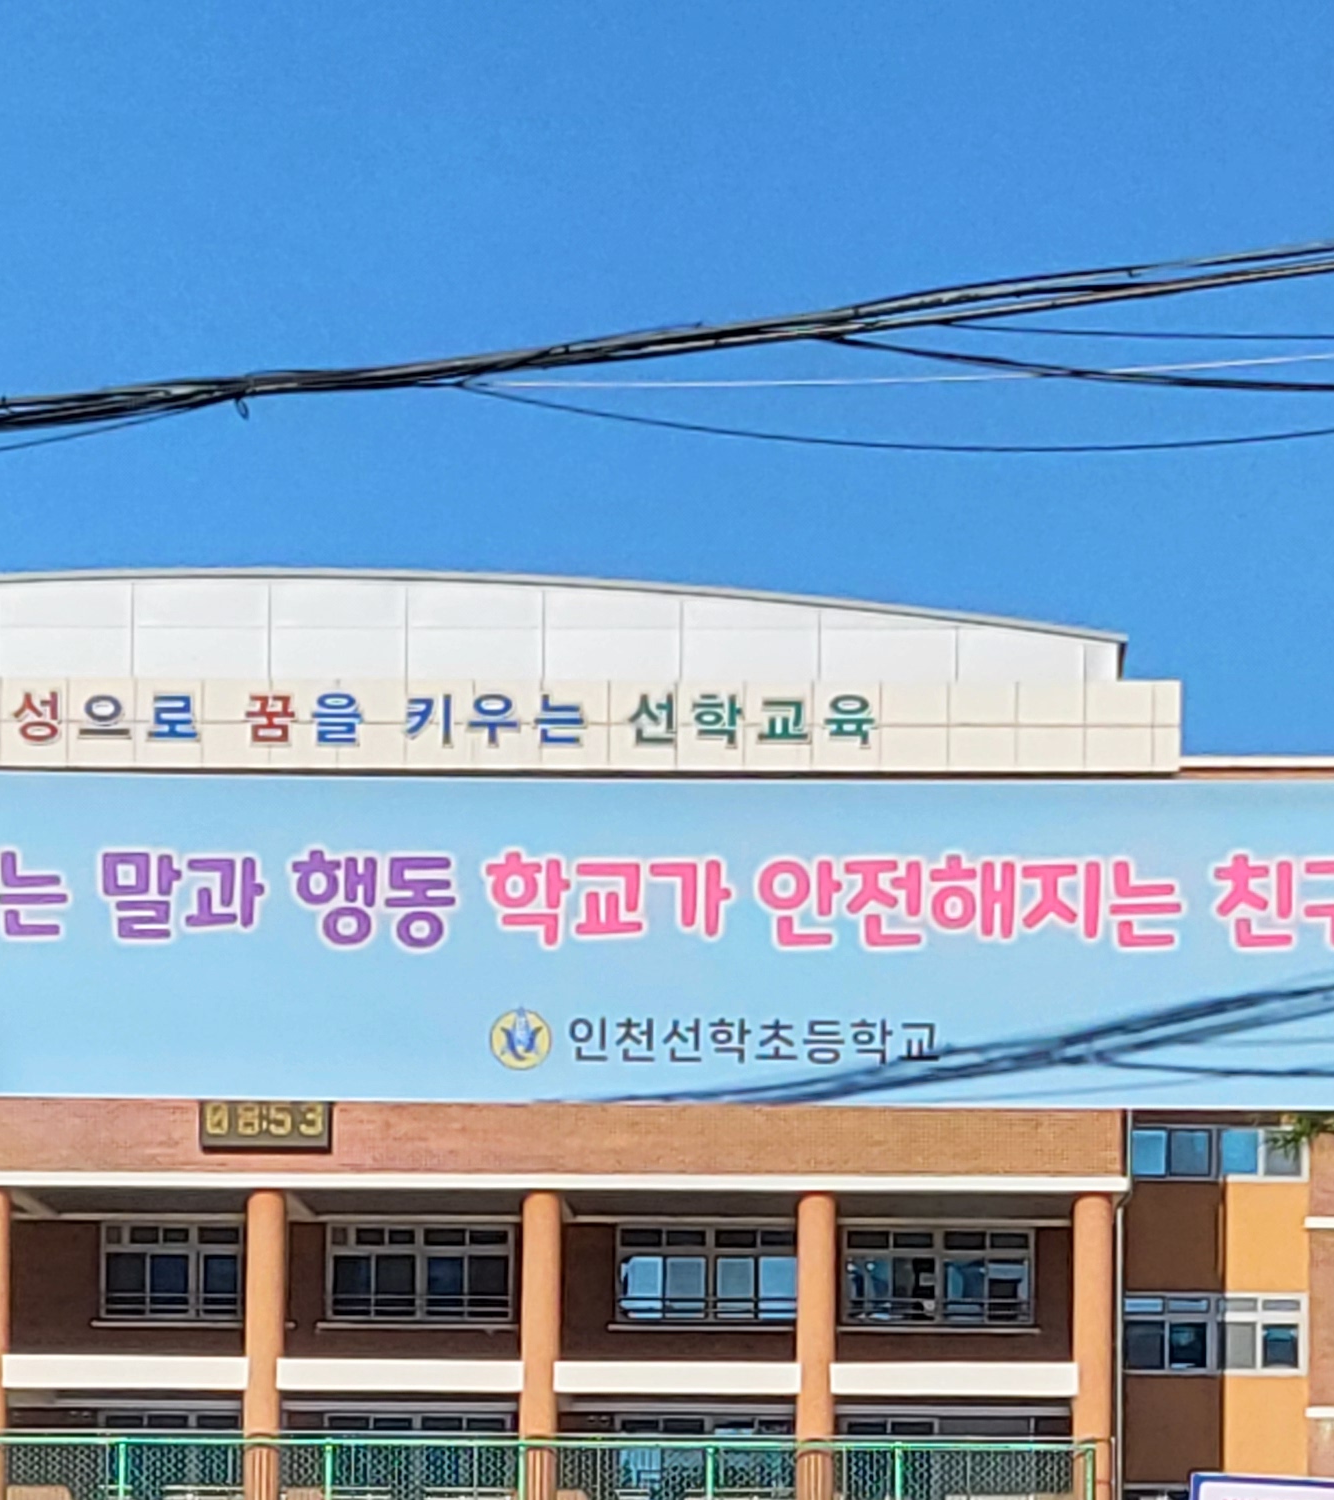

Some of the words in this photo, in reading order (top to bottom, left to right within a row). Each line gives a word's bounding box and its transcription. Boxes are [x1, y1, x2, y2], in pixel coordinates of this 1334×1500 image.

[244, 693, 364, 746] 꿈을
[405, 693, 588, 748] 키우는
[628, 693, 877, 748] 선학교육
[100, 850, 265, 941] 말과
[291, 848, 457, 951] 행동
[485, 850, 733, 948] 학교가
[755, 853, 1182, 950] 안전해지는
[567, 1016, 942, 1063] 인천선학초등학교
